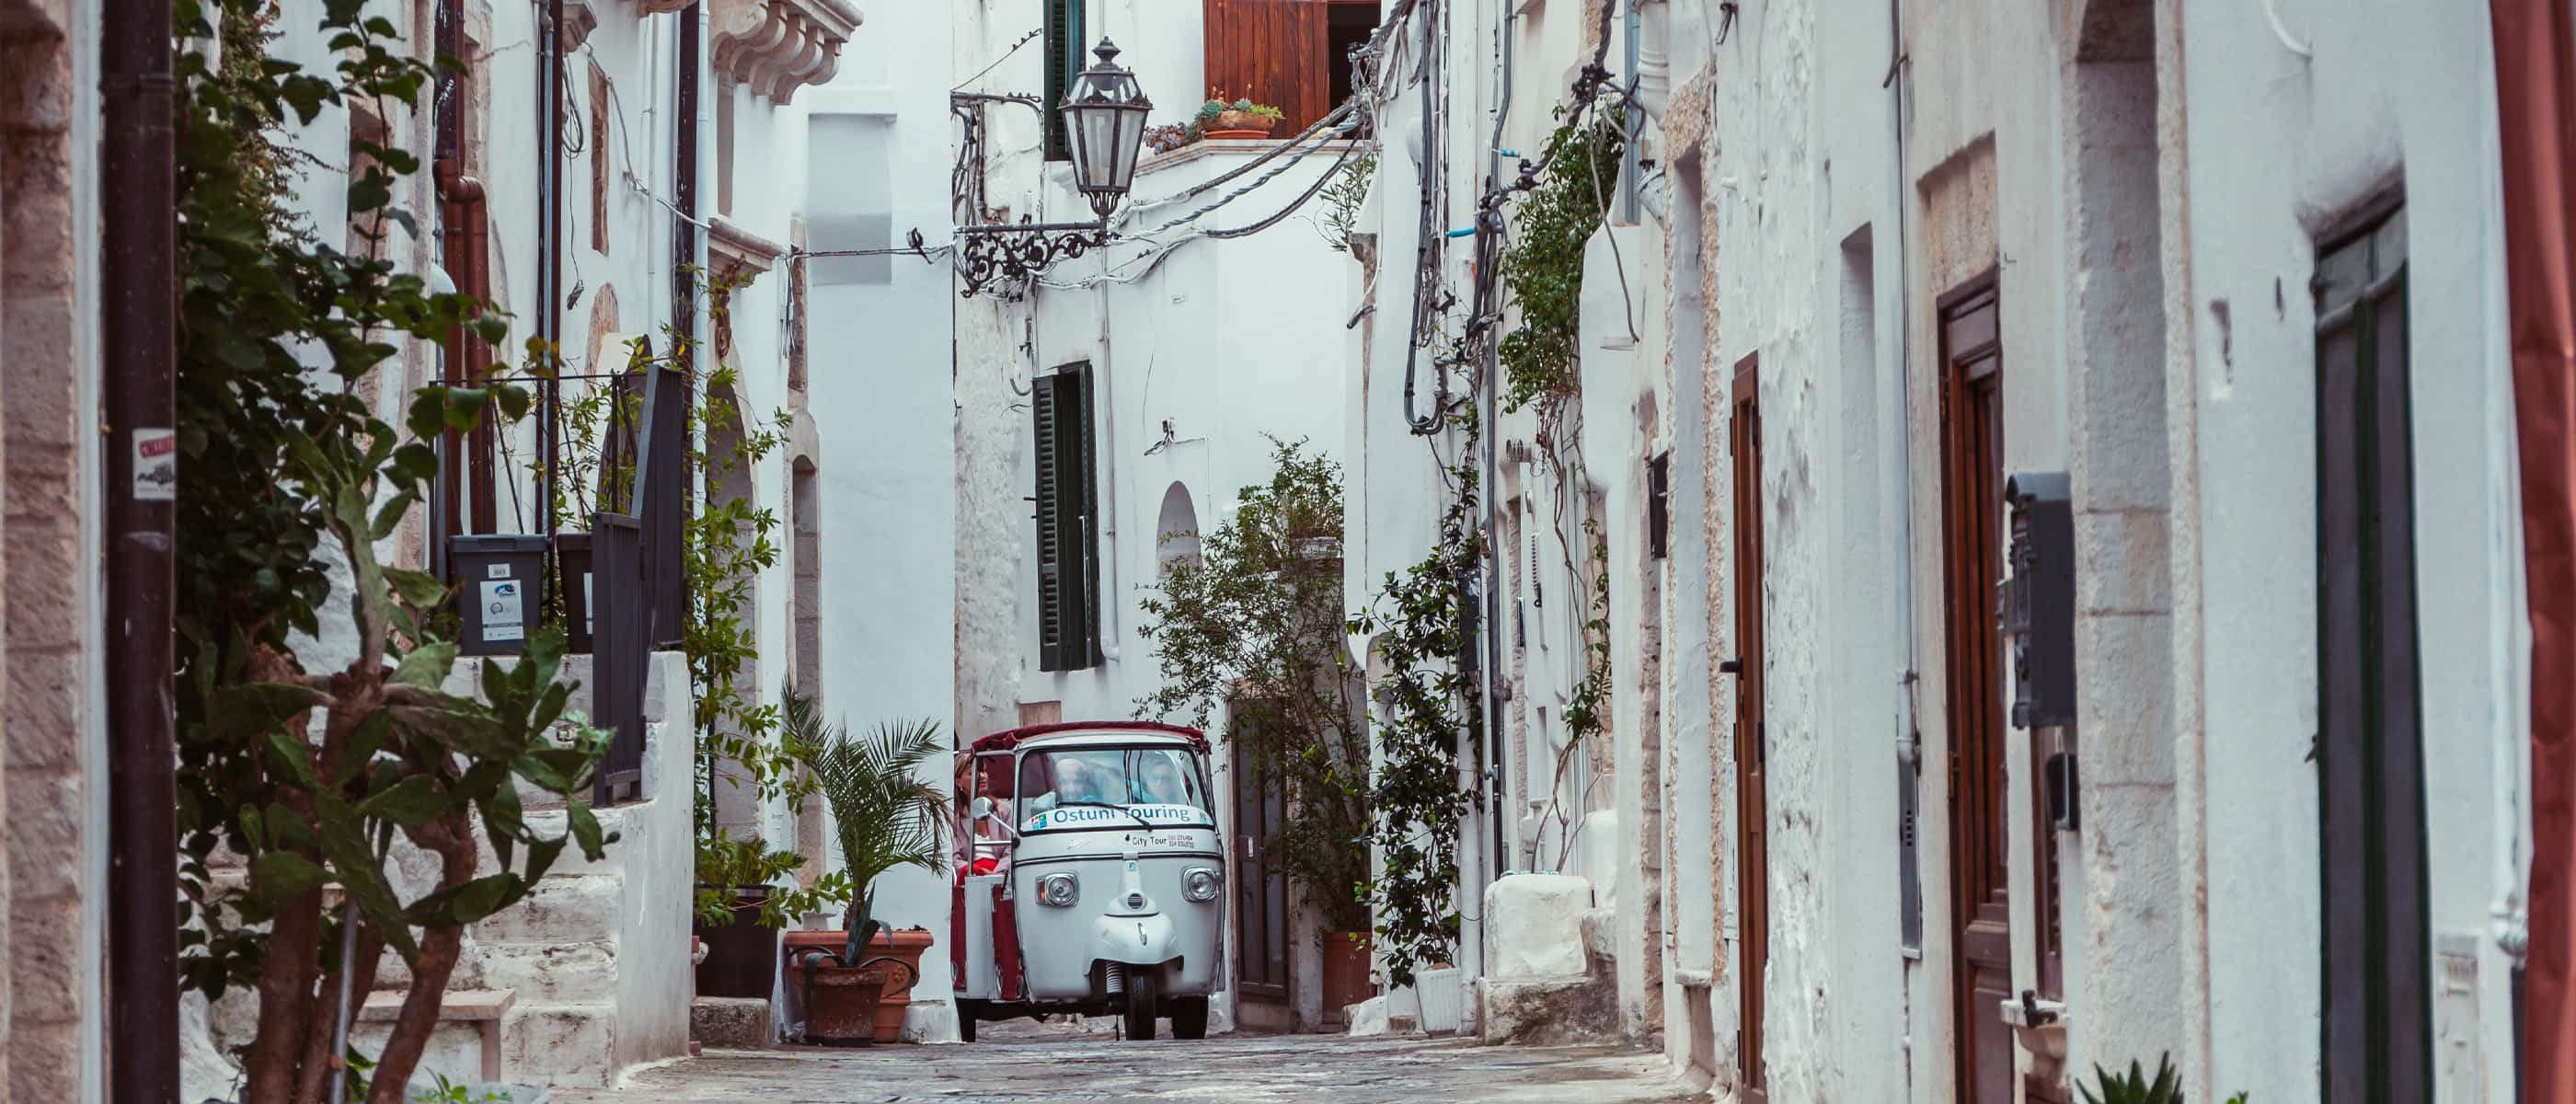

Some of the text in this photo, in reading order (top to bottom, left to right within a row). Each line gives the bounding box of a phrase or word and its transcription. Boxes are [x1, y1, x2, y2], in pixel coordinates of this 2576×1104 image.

[1053, 809, 1115, 823] Ostuni
[1133, 836, 1147, 847] City
[1149, 835, 1167, 845] Tour
